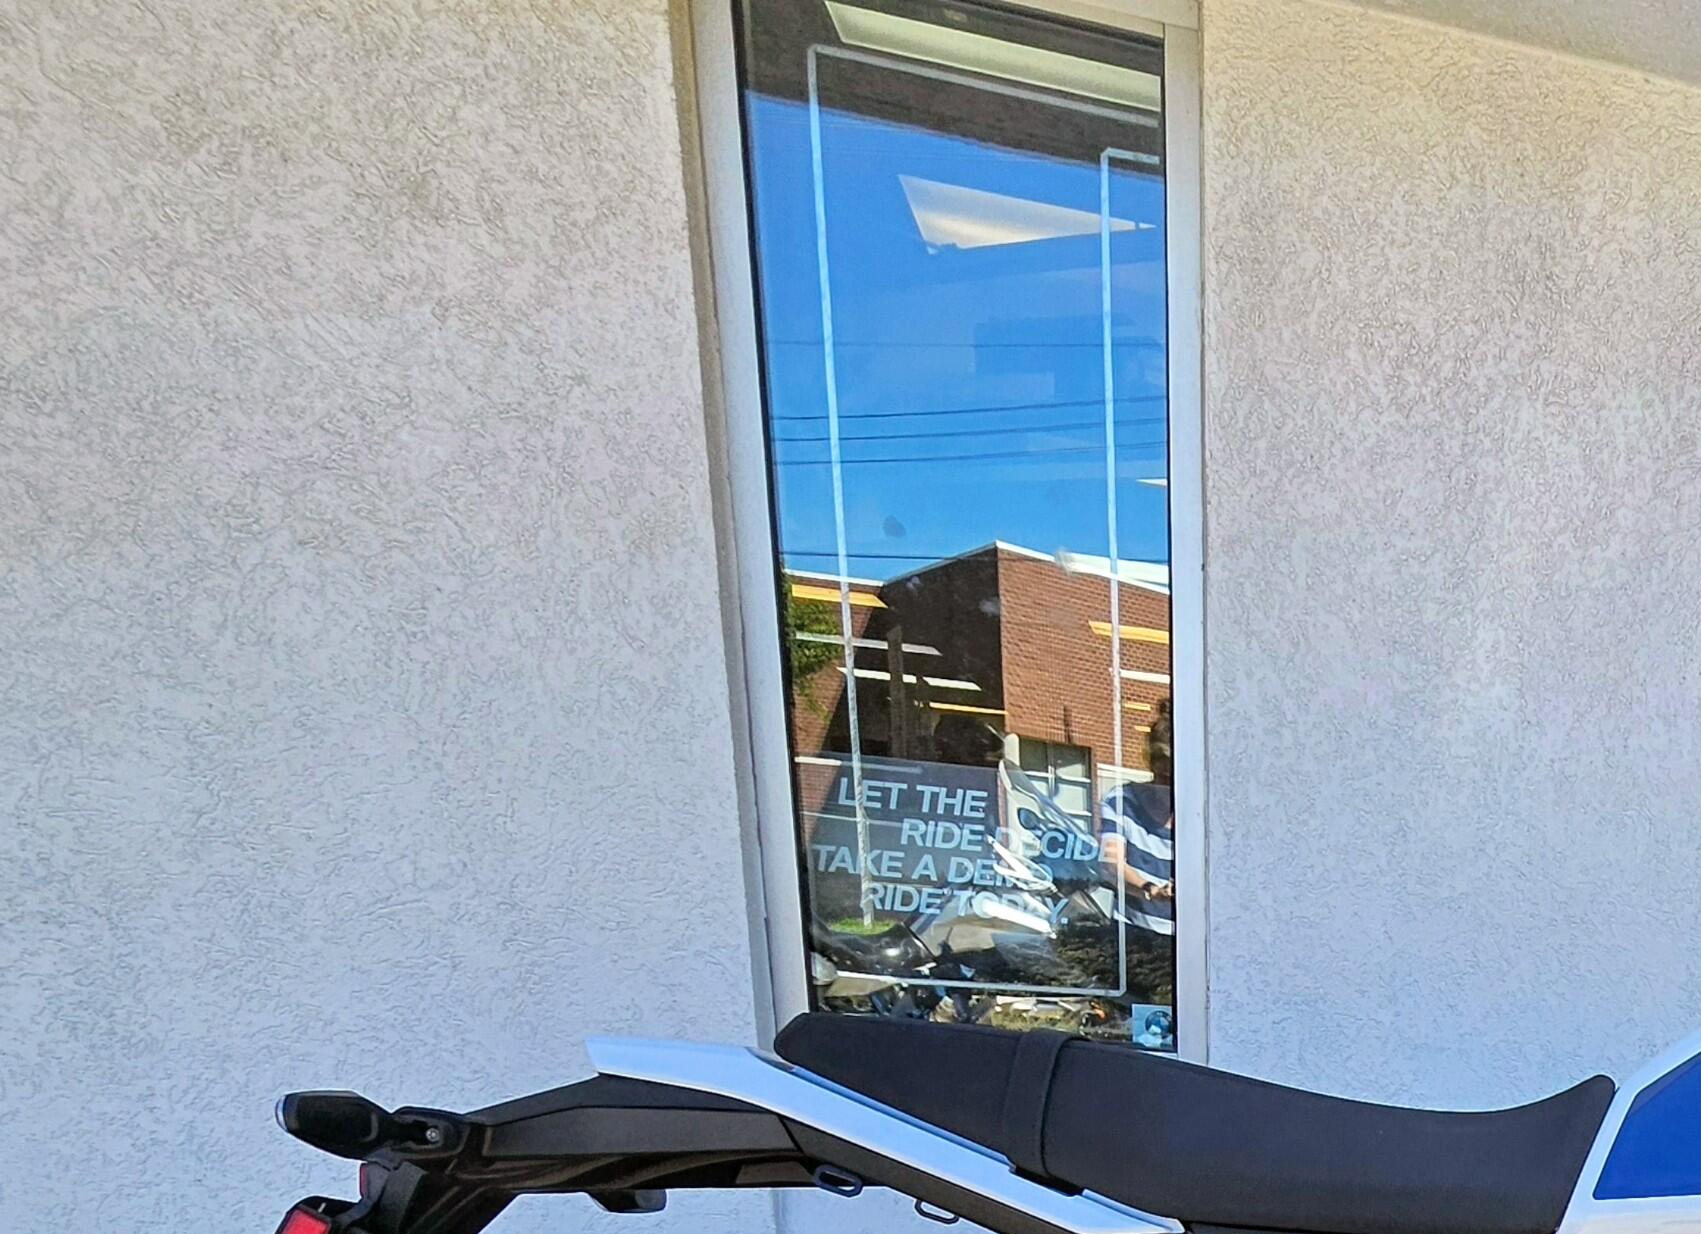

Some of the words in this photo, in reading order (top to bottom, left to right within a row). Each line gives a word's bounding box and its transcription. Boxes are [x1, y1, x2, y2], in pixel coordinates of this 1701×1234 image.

[837, 777, 908, 810] LET
[916, 784, 988, 818] THE
[901, 817, 985, 852] RIDE
[812, 844, 905, 879] TAKE
[911, 854, 938, 882] A
[866, 881, 942, 915] RIDE
